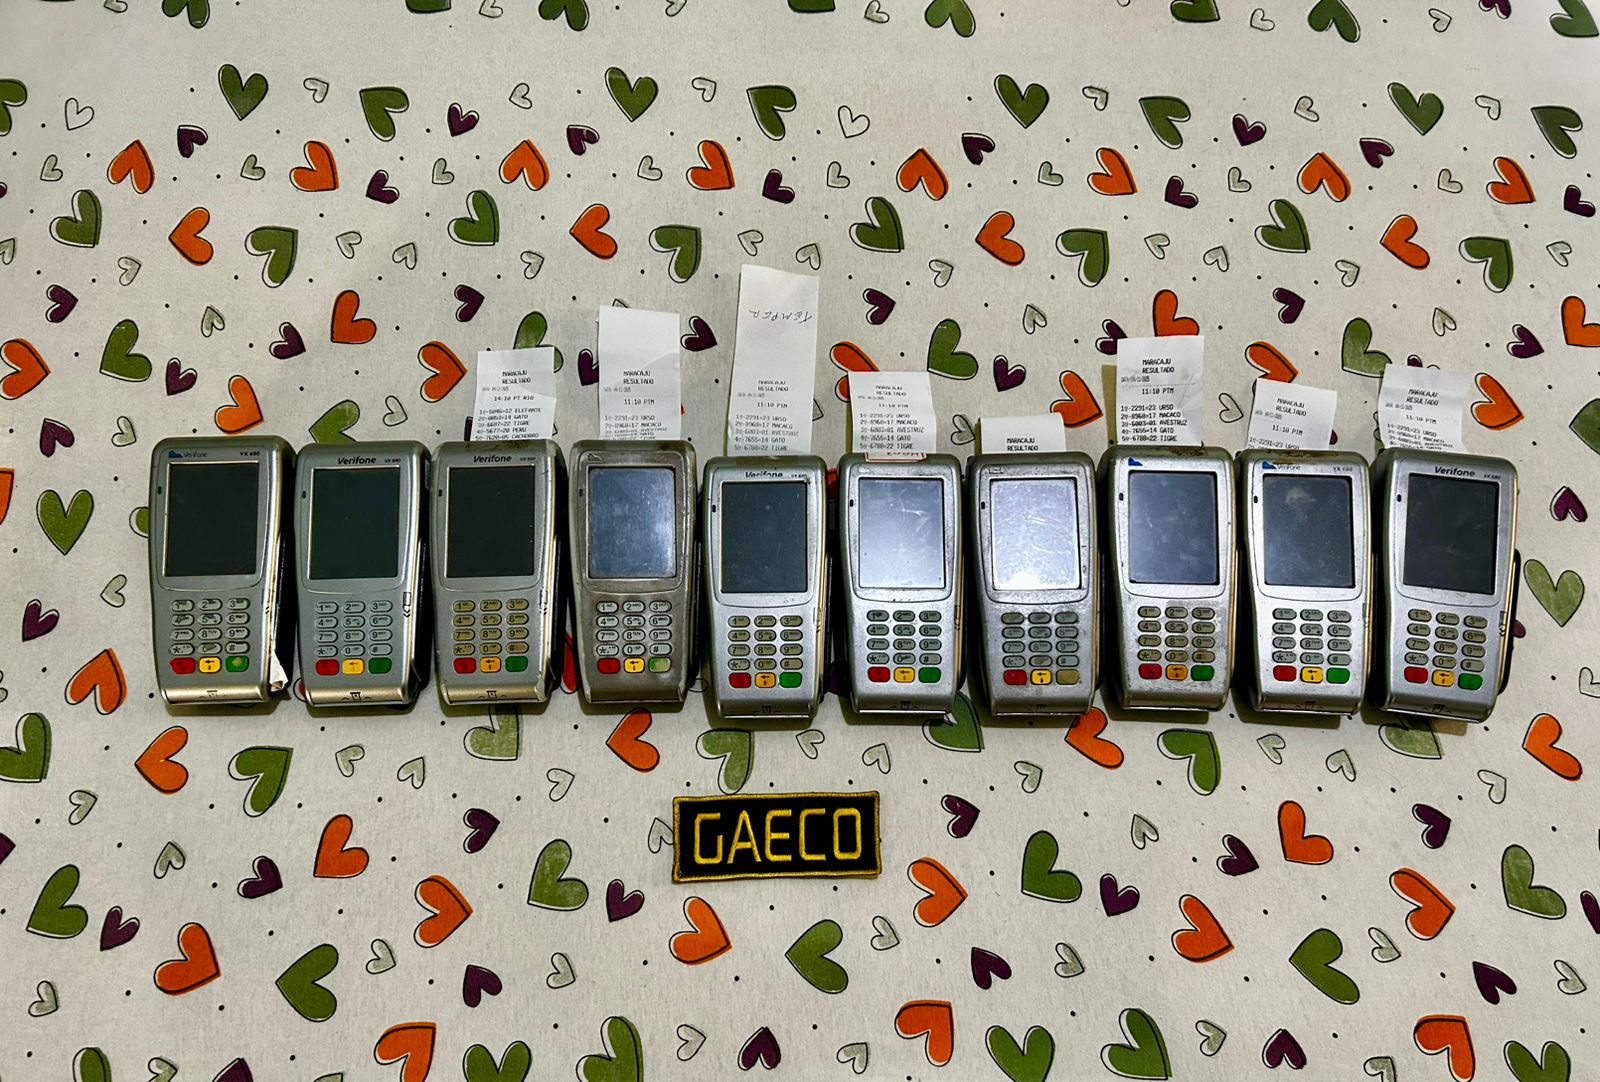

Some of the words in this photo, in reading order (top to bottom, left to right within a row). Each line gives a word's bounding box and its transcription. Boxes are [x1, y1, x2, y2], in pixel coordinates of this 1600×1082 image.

[1141, 387, 1160, 395] 11:10
[1406, 396, 1439, 406] RESULTADO
[1272, 424, 1290, 433] 11:10
[337, 456, 377, 465] Verifone
[473, 455, 512, 464] Verifone
[1435, 466, 1475, 477] Verifone
[694, 807, 862, 865] GAECO
